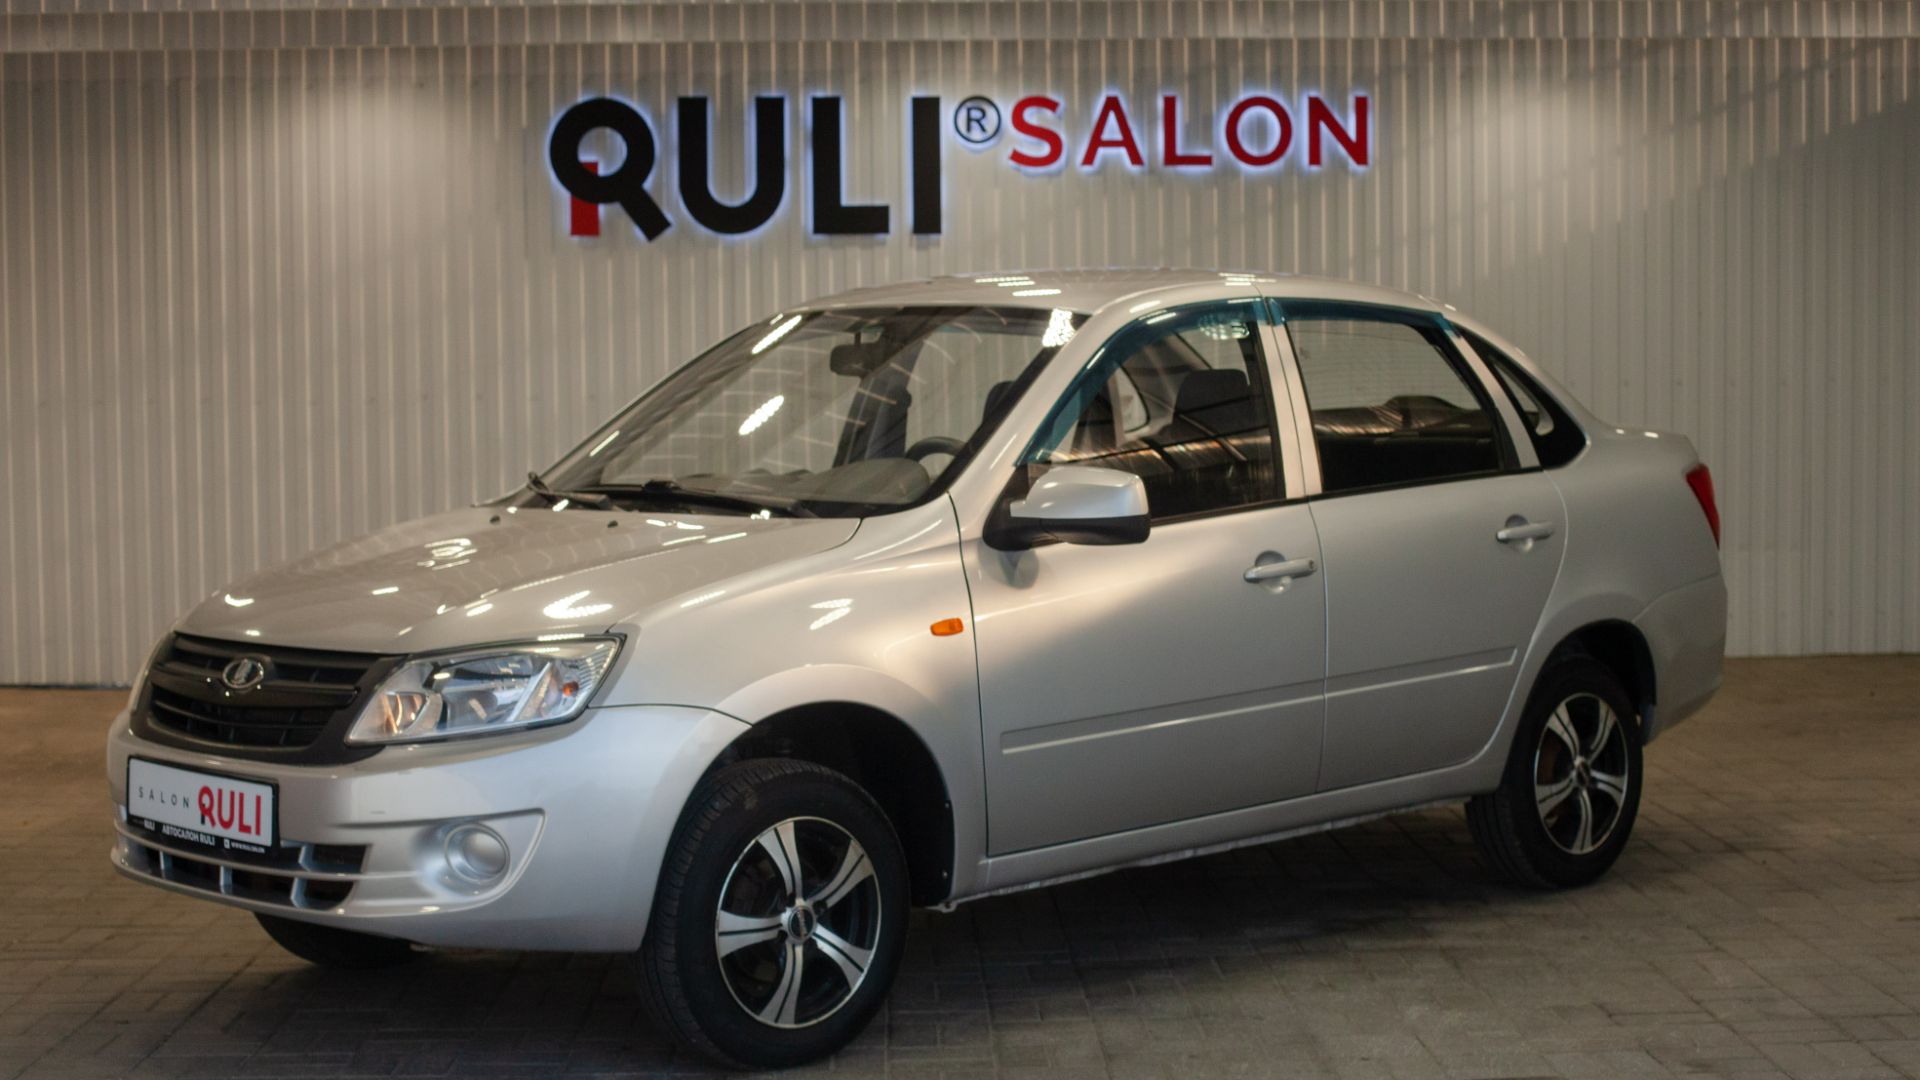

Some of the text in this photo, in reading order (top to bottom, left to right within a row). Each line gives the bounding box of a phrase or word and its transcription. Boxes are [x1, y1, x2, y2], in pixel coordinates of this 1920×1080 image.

[1009, 96, 1369, 168] SALON
[138, 785, 262, 836] SALON RULI
[161, 823, 199, 843] АВТОСАЛОН
